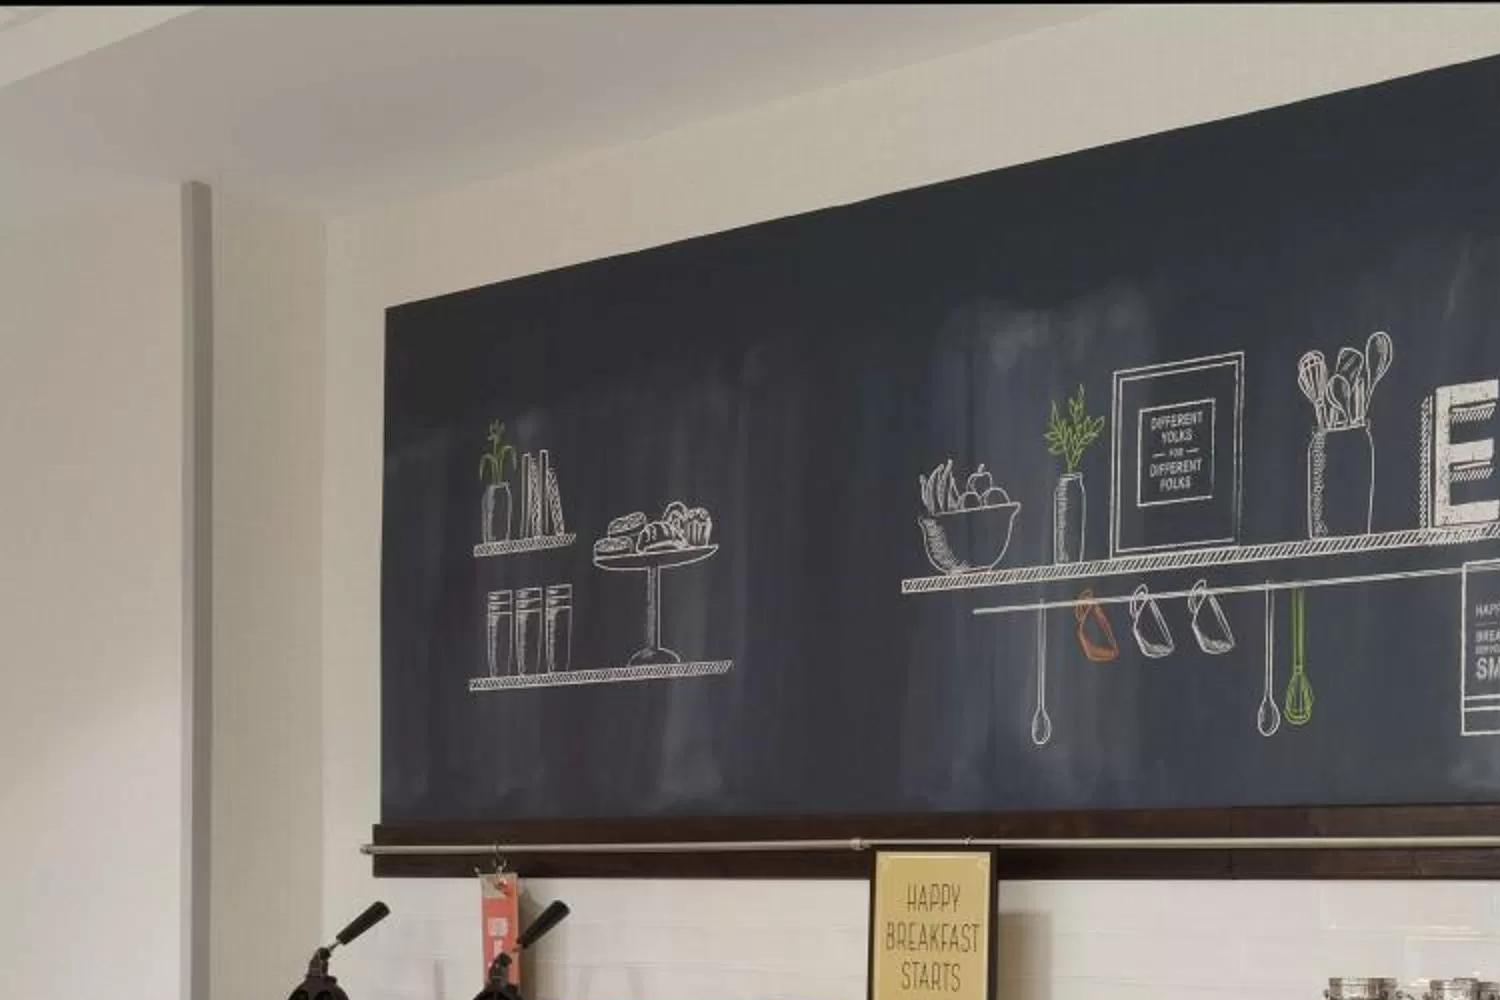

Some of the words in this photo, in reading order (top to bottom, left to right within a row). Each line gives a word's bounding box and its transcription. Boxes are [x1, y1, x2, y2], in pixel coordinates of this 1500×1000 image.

[1149, 458, 1202, 478] DIFFERENT
[906, 883, 961, 912] HAPPY
[886, 921, 981, 953] BREAKFAST
[901, 961, 961, 992] STARTS
